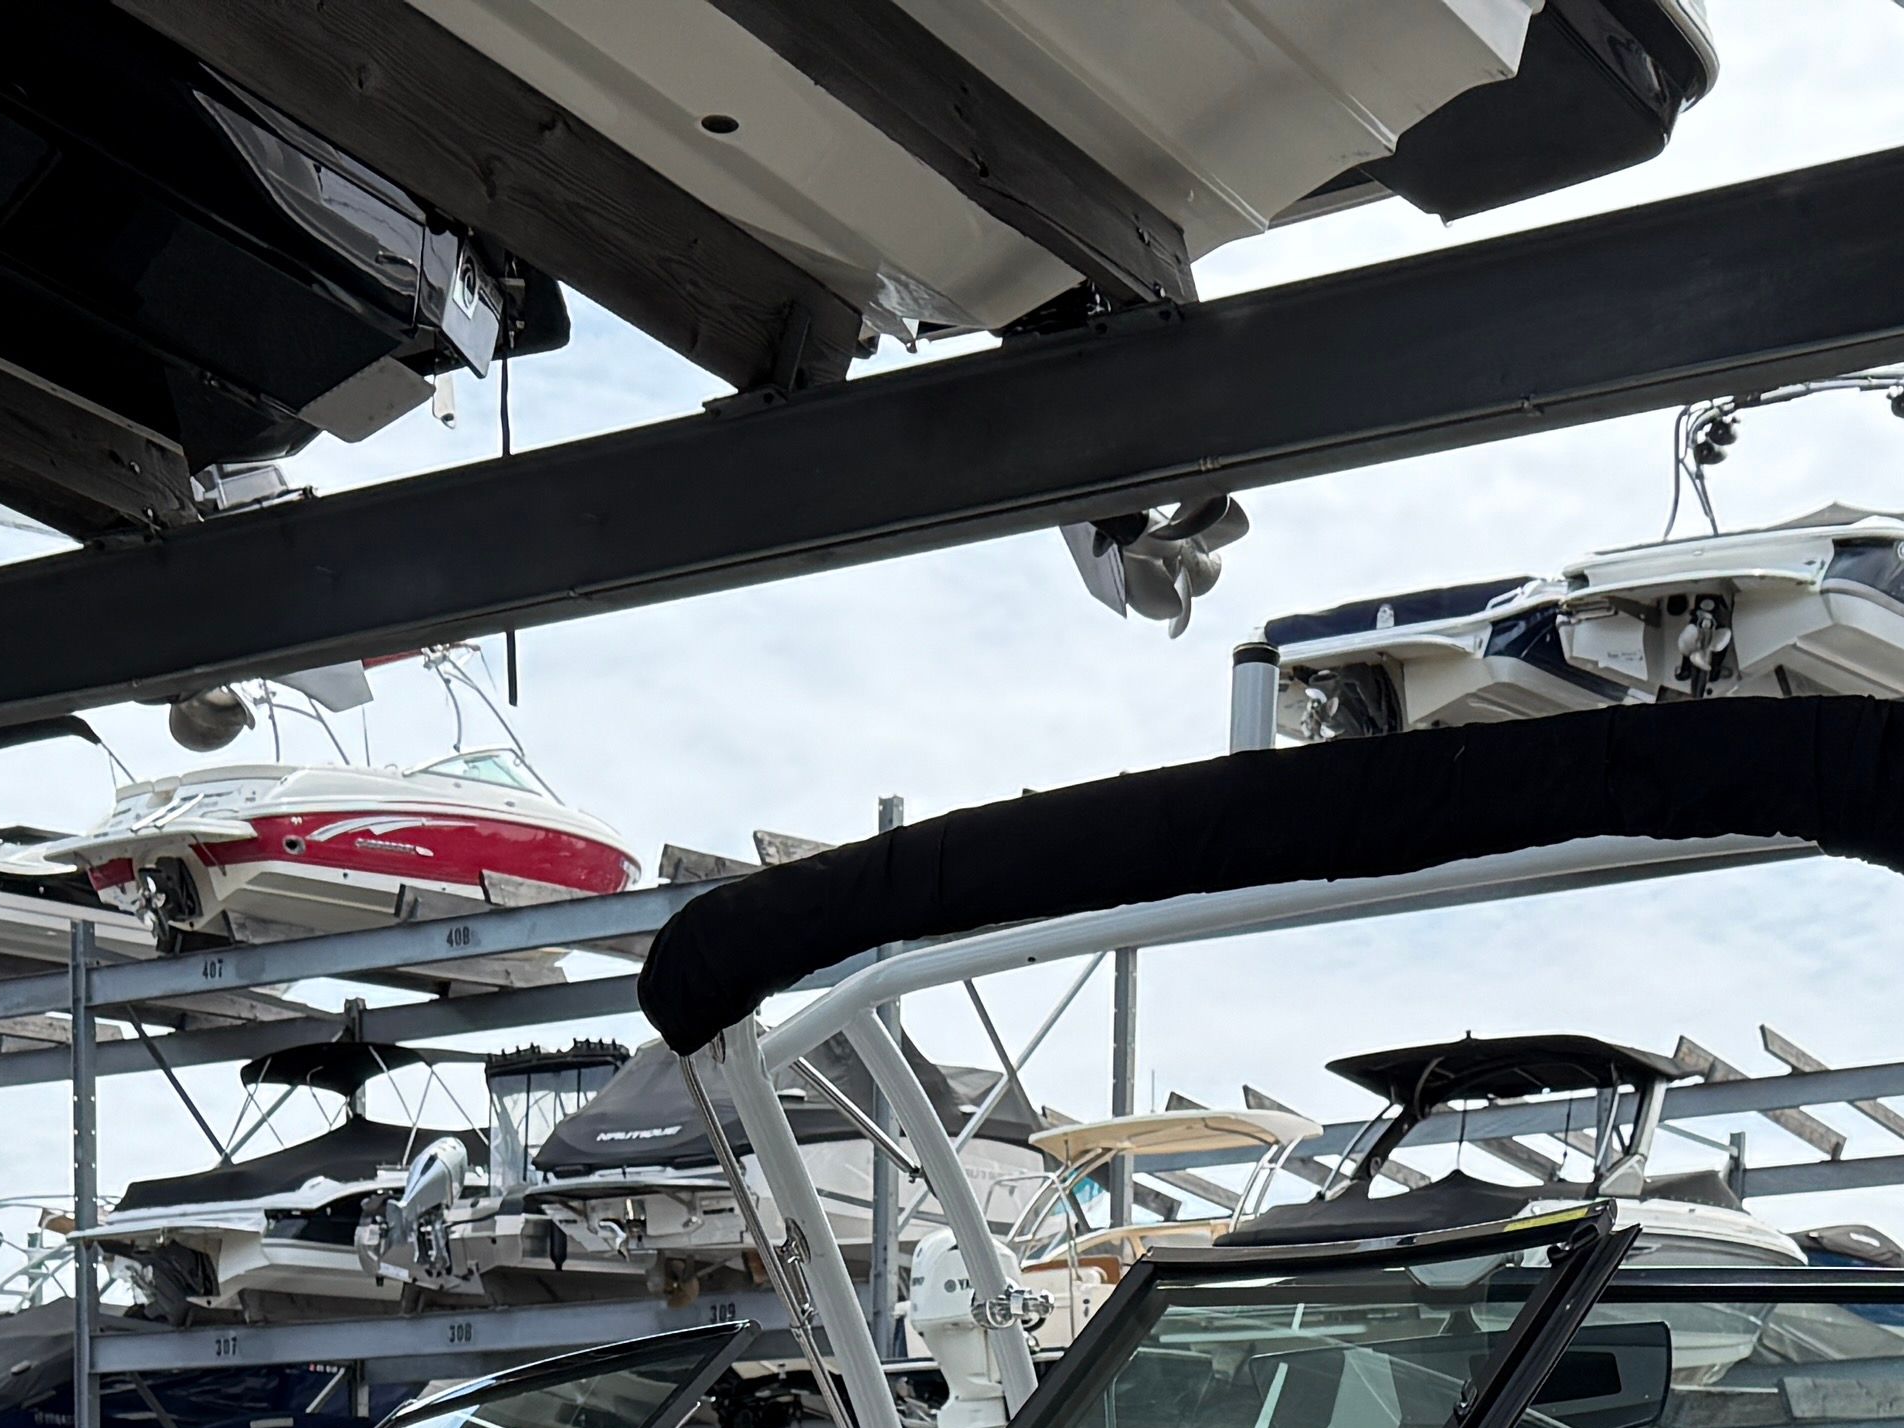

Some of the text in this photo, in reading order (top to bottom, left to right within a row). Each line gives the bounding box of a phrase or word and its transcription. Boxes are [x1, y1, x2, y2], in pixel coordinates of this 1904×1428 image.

[202, 958, 224, 979] 407
[709, 1302, 737, 1324] 309
[448, 1322, 473, 1343] 308
[214, 1336, 238, 1357] 307
